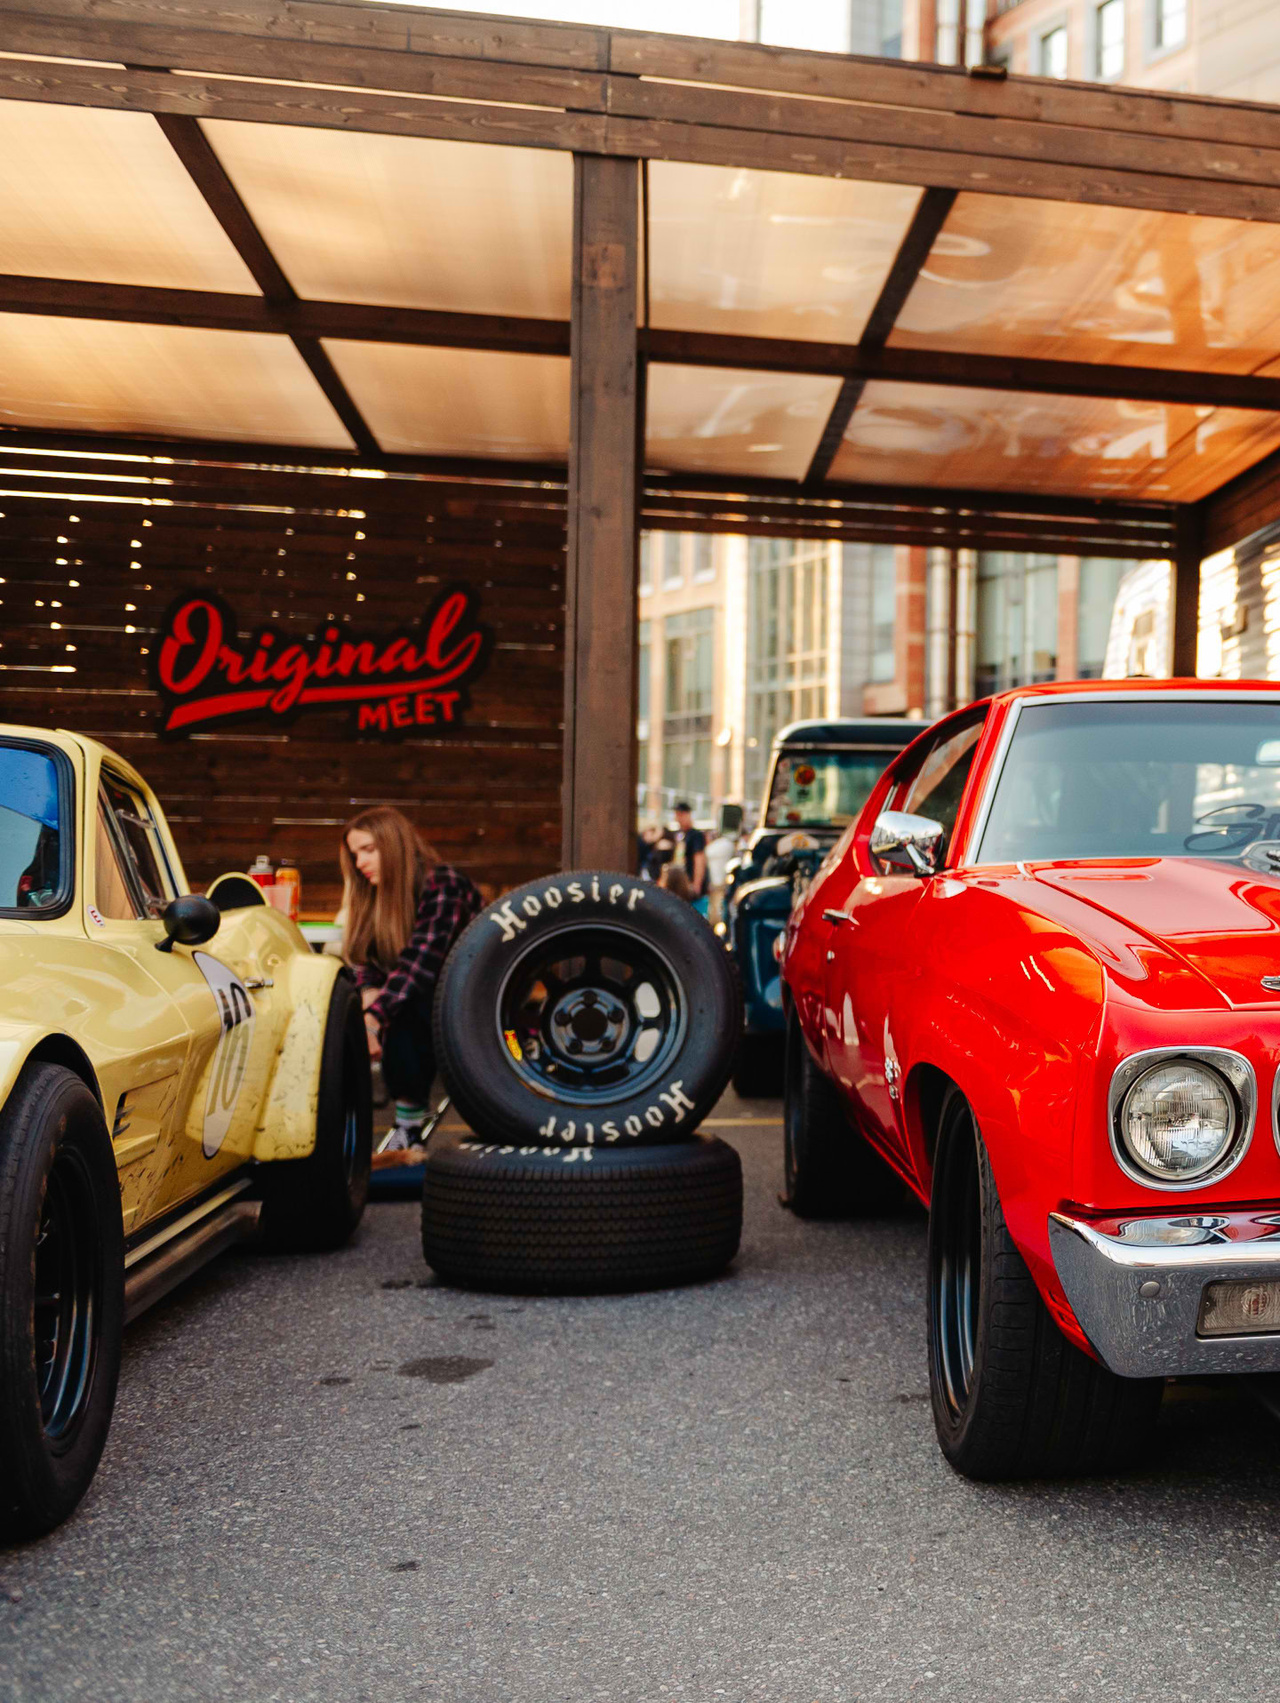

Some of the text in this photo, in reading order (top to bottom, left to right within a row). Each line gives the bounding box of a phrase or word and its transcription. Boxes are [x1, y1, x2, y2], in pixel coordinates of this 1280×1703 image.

[159, 592, 482, 722] Original
[358, 691, 460, 732] MEET
[490, 875, 645, 942] Hoosier
[539, 1080, 695, 1143] Hoosier
